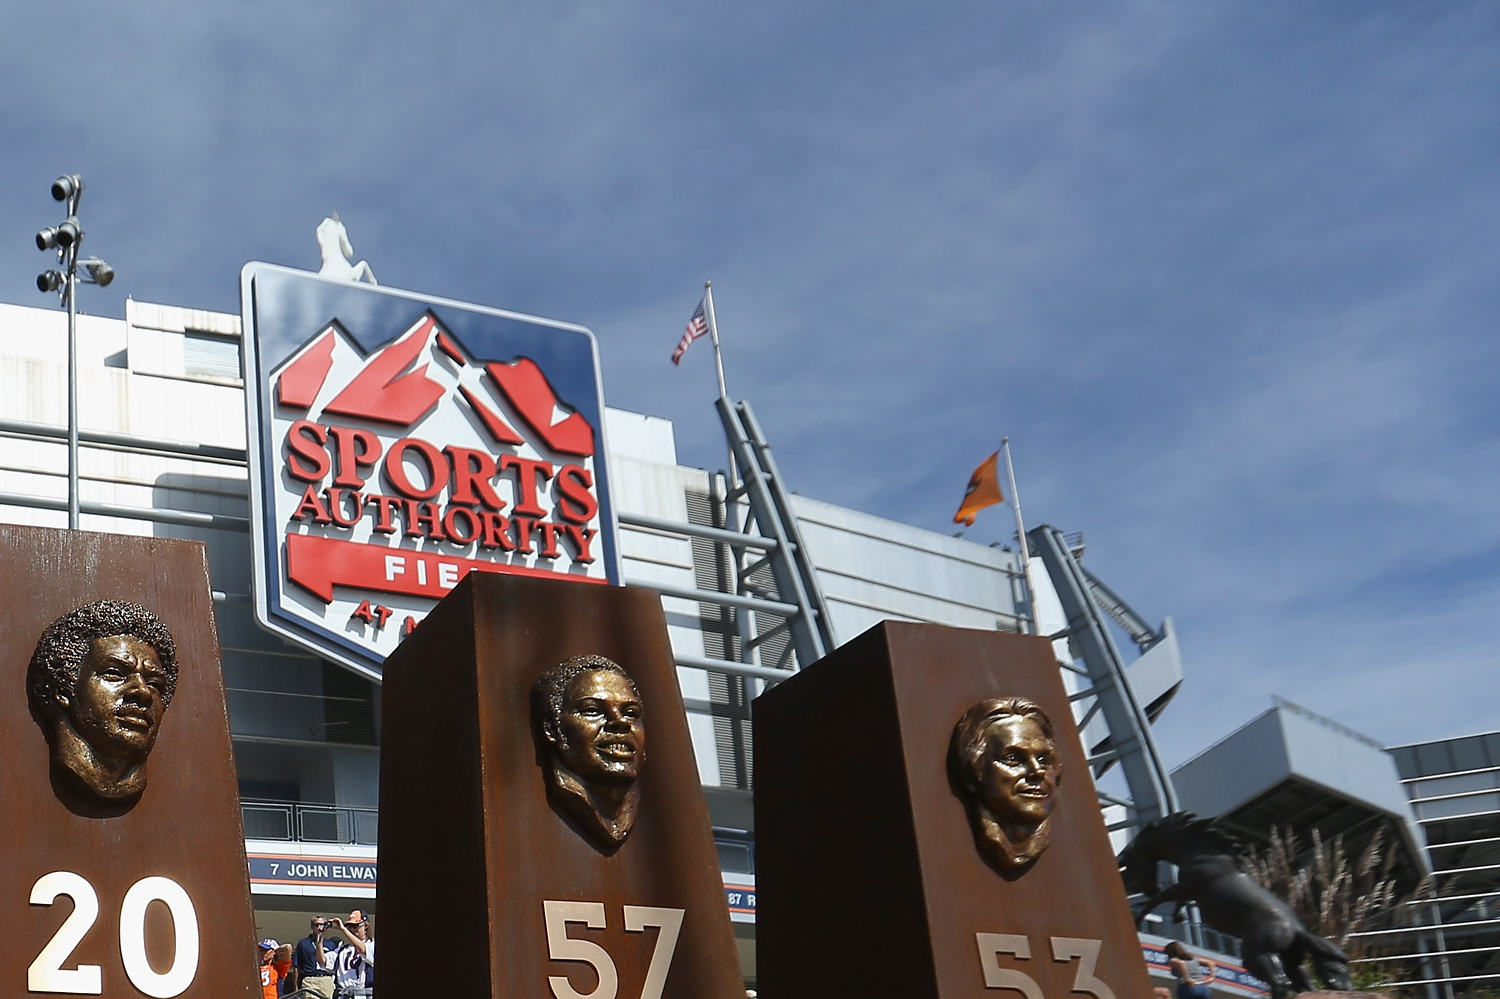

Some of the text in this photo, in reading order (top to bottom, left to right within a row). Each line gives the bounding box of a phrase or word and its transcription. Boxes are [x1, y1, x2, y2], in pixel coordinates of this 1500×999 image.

[287, 419, 598, 524] SPORTS
[290, 484, 600, 564] AUTHORITY
[385, 555, 470, 588] FIE
[350, 599, 393, 627] AT
[270, 864, 279, 875] 7
[287, 864, 328, 877] JOHN
[728, 893, 742, 905] 87
[27, 871, 199, 999] 20
